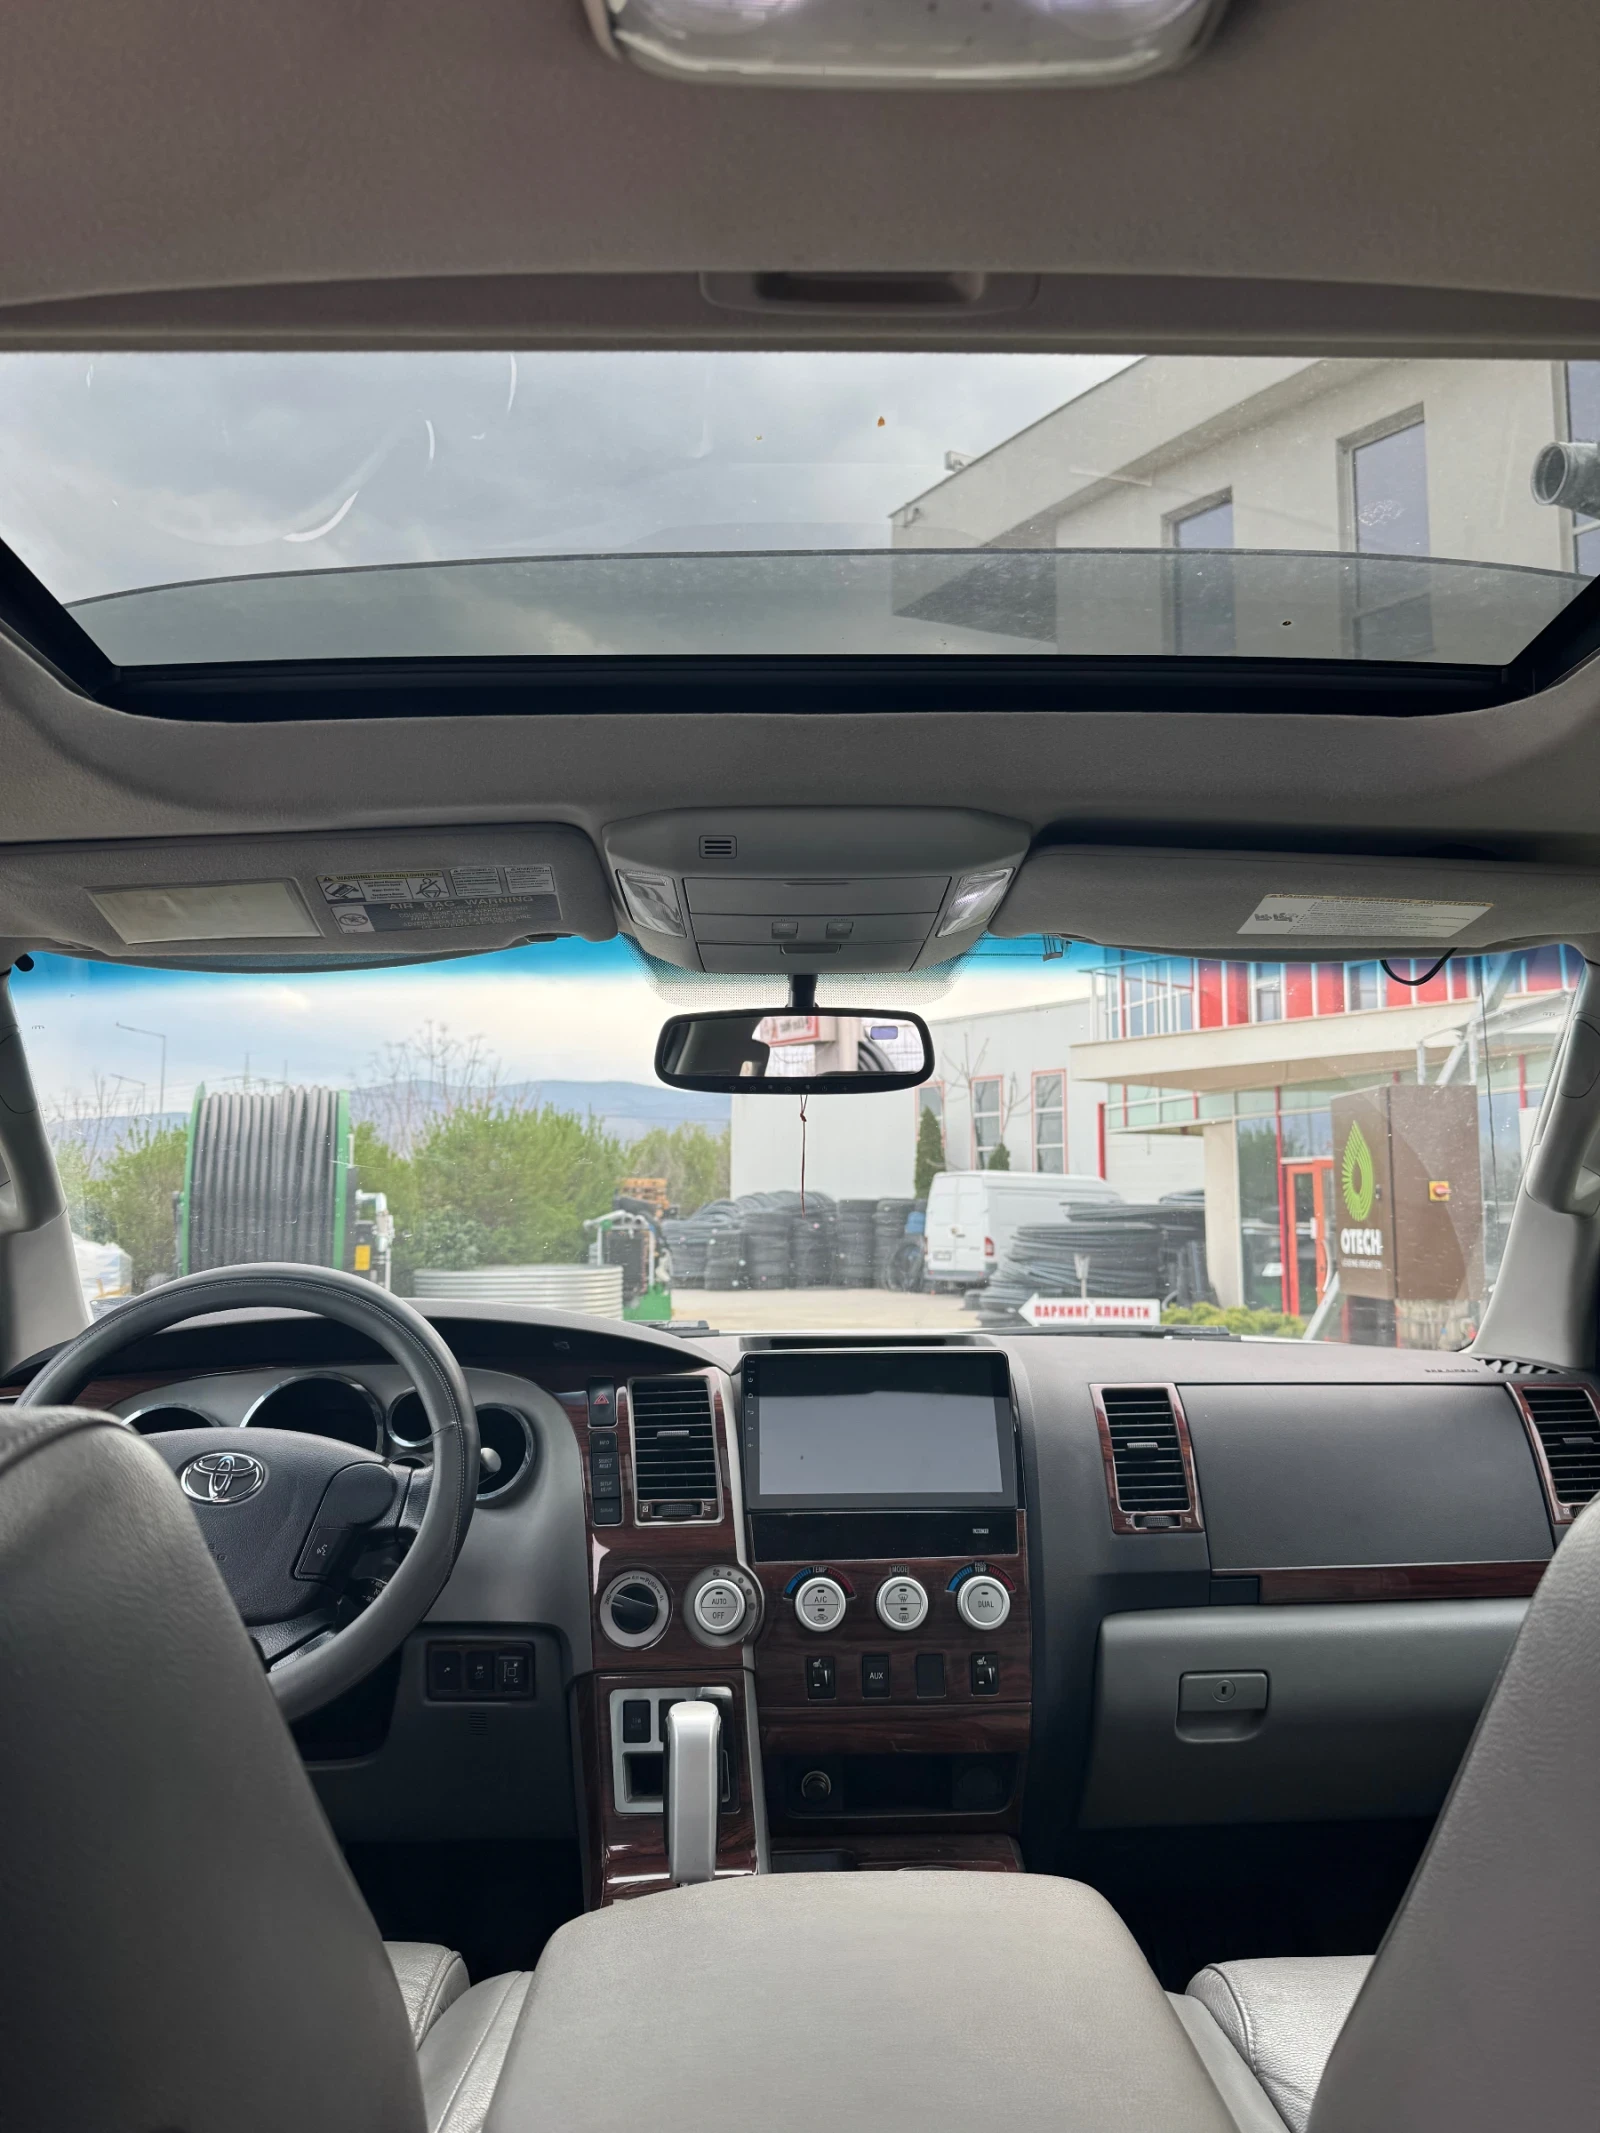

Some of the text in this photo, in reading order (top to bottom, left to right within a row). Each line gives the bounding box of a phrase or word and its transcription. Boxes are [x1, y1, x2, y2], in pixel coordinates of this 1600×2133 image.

[389, 902, 414, 910] AIR
[423, 900, 455, 909] BAG
[465, 896, 534, 906] WARNING
[1341, 1228, 1382, 1255] OTECH
[1034, 1304, 1149, 1317] ПАРКИНГ КЛИЕНТИ
[977, 1600, 994, 1608] DUAL
[712, 1611, 725, 1619] OFF
[869, 1672, 884, 1680] AUX
